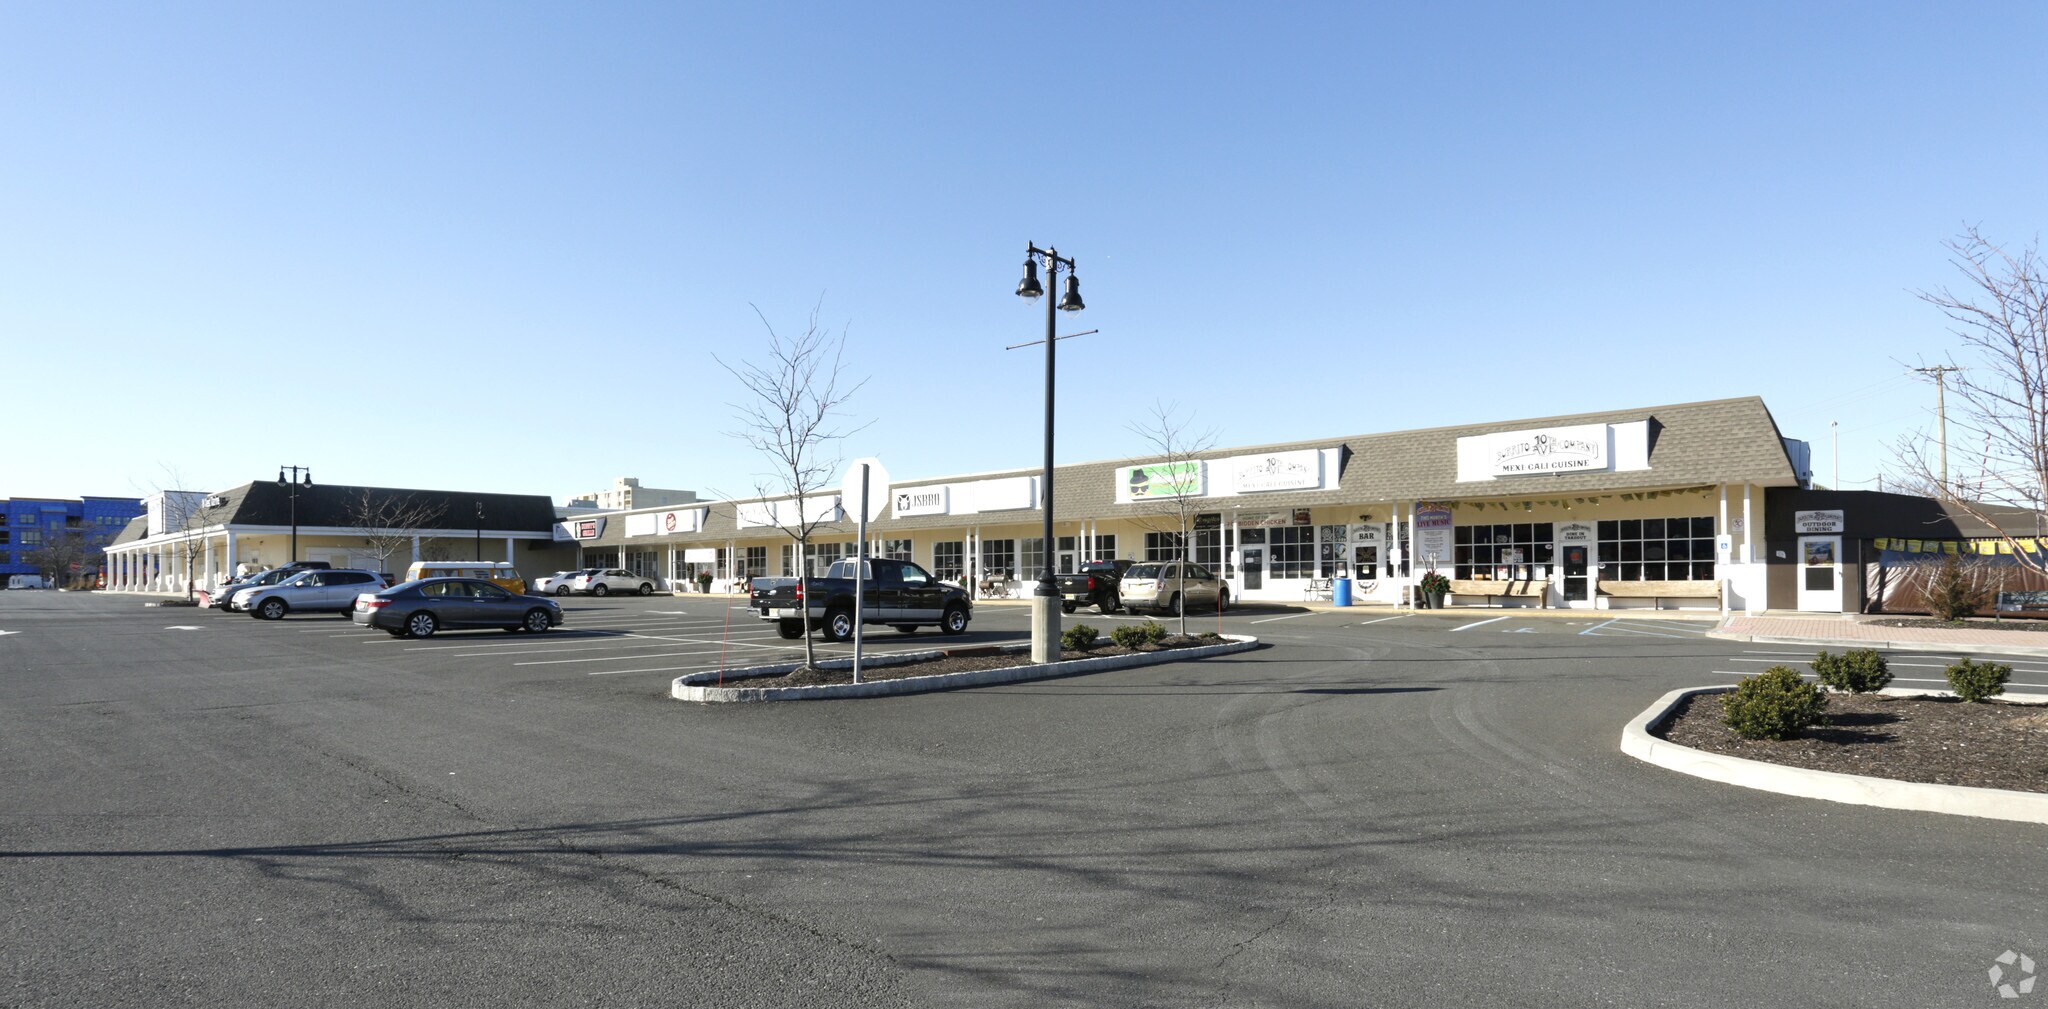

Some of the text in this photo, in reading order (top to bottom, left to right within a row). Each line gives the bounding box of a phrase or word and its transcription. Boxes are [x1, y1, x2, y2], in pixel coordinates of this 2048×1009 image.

[1551, 460, 1589, 469] CUISINE
[1227, 519, 1259, 527] FOBIDDEN
[1431, 519, 1450, 527] MUSIC
[1358, 532, 1375, 540] BAR
